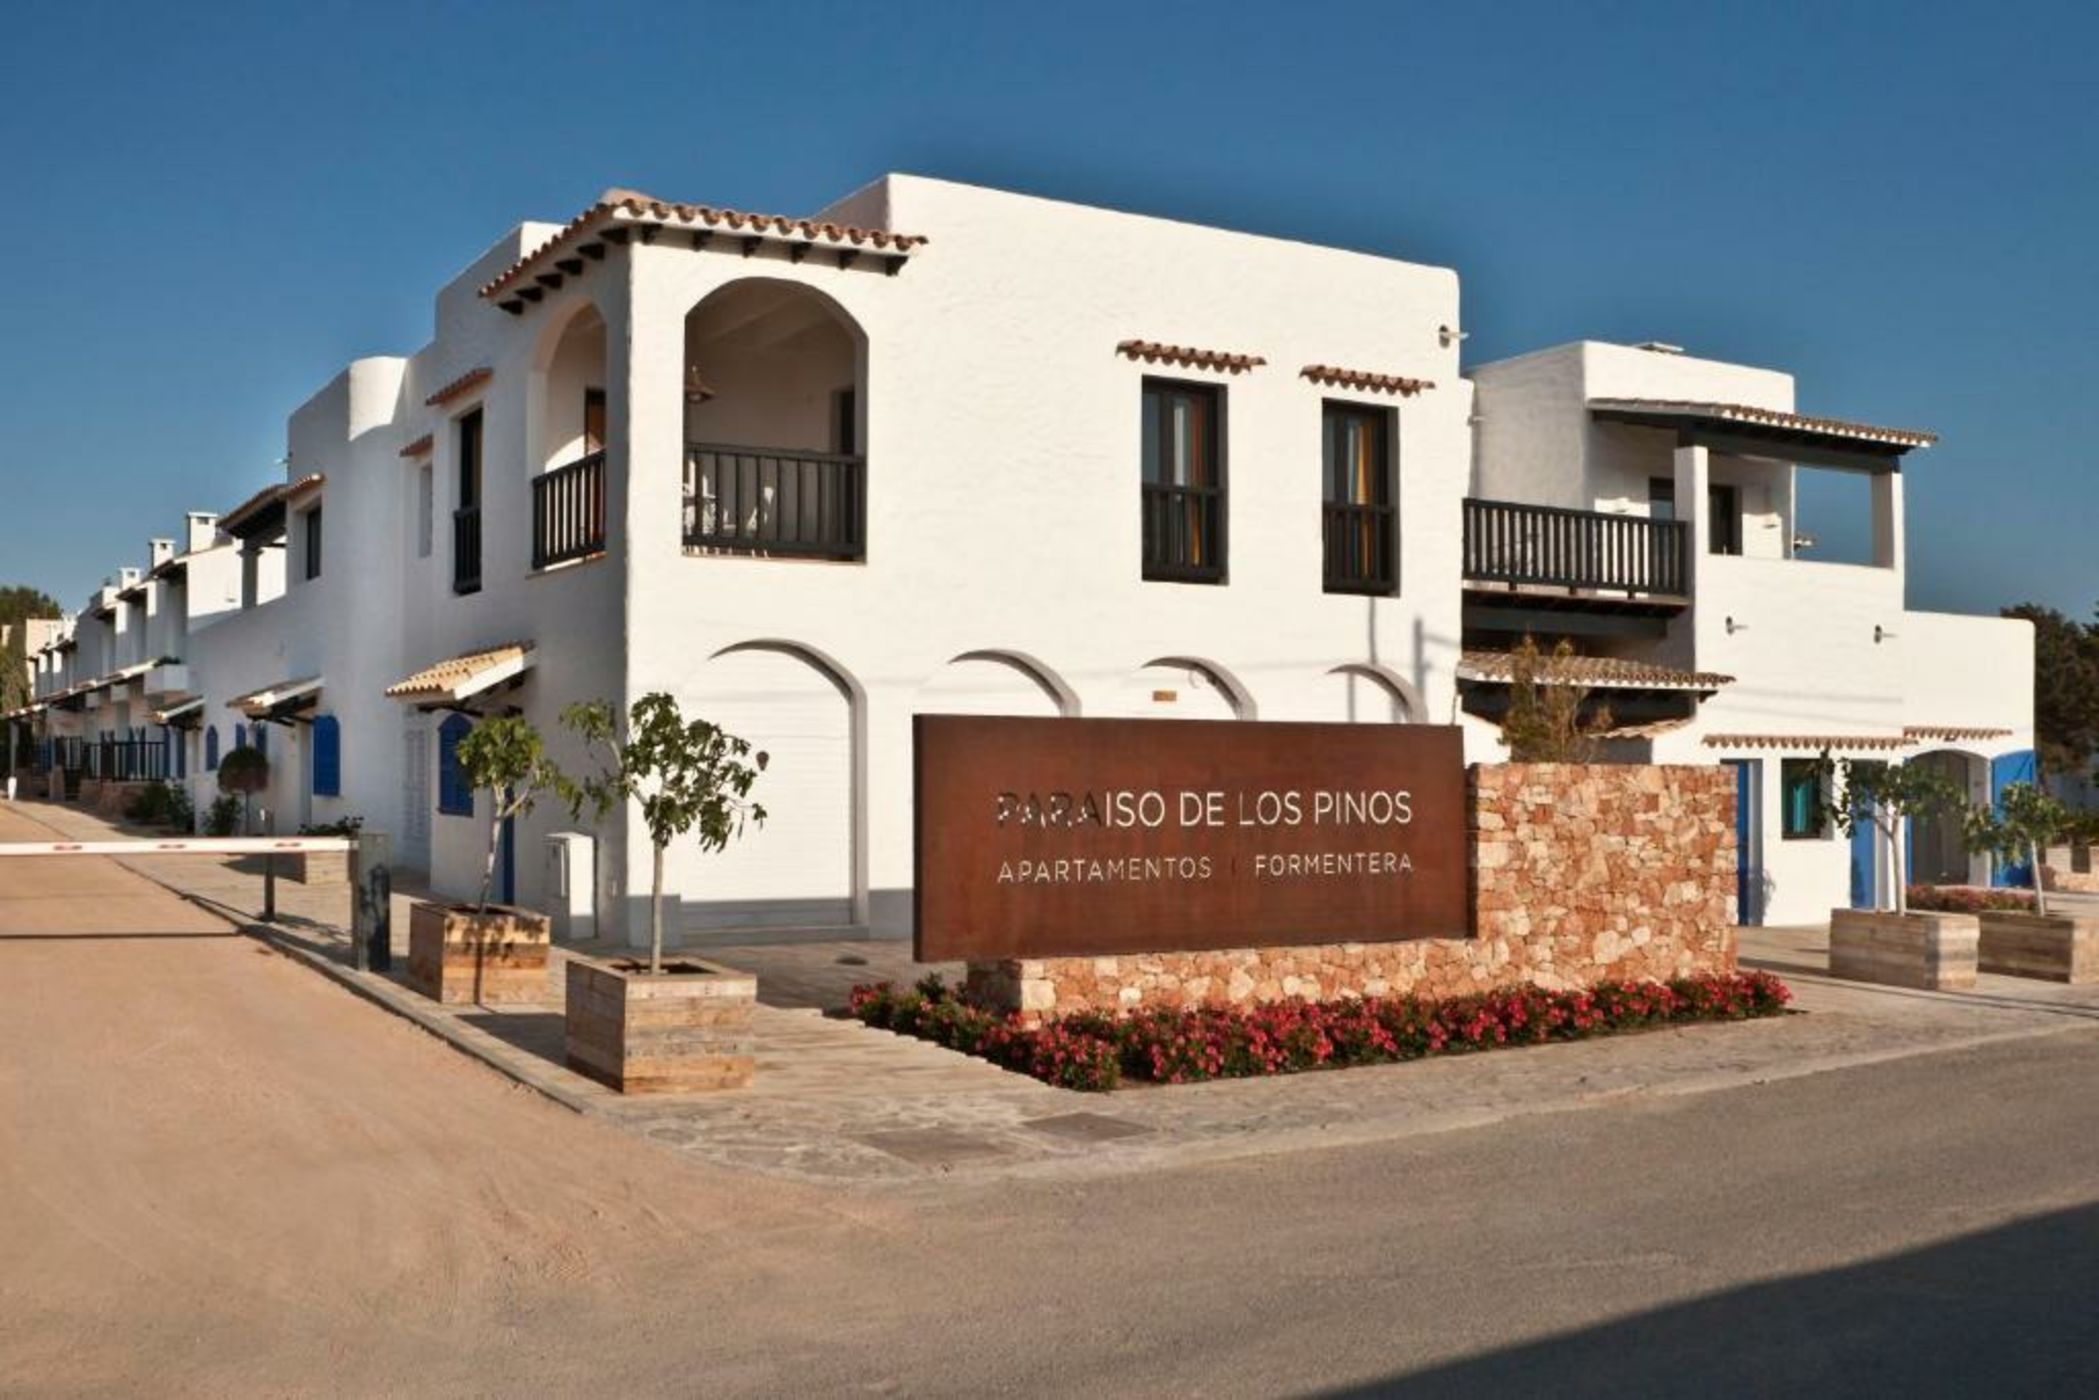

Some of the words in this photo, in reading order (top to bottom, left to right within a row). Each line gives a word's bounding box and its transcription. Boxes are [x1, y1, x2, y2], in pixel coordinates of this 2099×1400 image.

[997, 791, 1166, 828] PARAISO
[1179, 792, 1225, 826] DE
[1239, 791, 1301, 825] LOS
[1314, 791, 1413, 825] PINOS
[997, 856, 1212, 883] APARTAMENTOS
[1255, 852, 1414, 876] FORMENTERA
